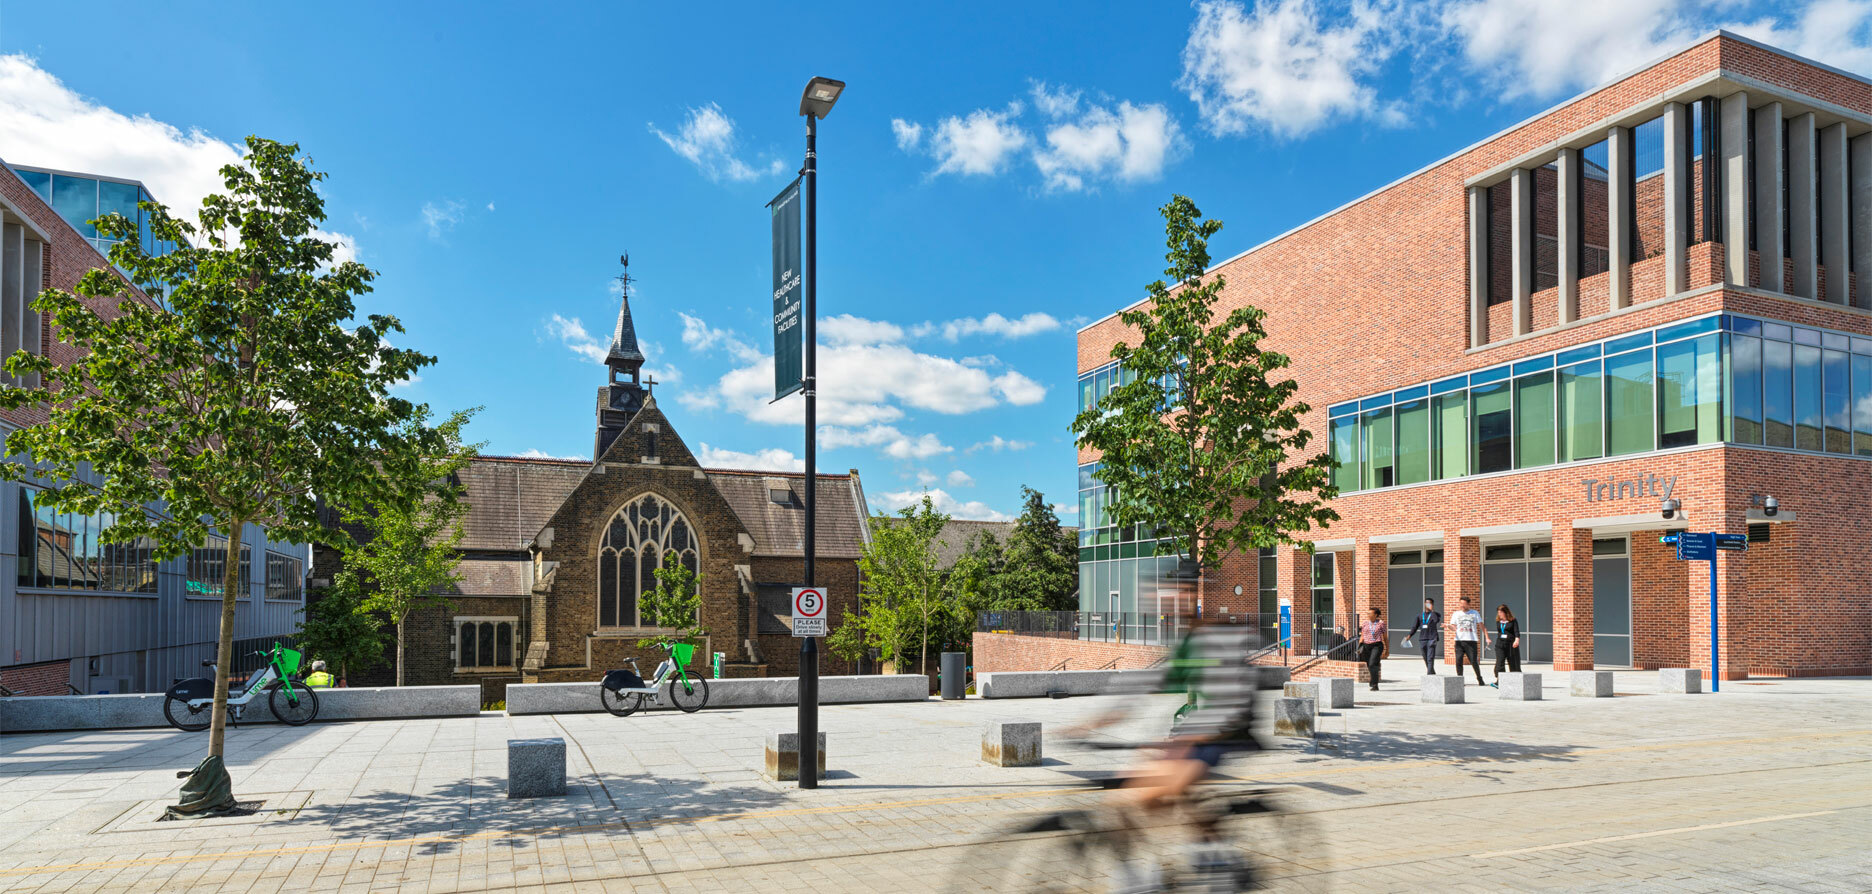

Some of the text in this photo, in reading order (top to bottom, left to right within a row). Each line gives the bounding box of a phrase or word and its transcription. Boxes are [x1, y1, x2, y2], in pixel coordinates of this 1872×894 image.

[782, 269, 792, 282] NEW
[774, 275, 800, 300] HEALTHCARE
[785, 296, 789, 305] &
[775, 300, 800, 324] COMMUNITY
[778, 315, 797, 334] FACILITIES
[1581, 472, 1677, 502] Trinity
[805, 594, 815, 608] 5
[248, 677, 267, 696] Lime
